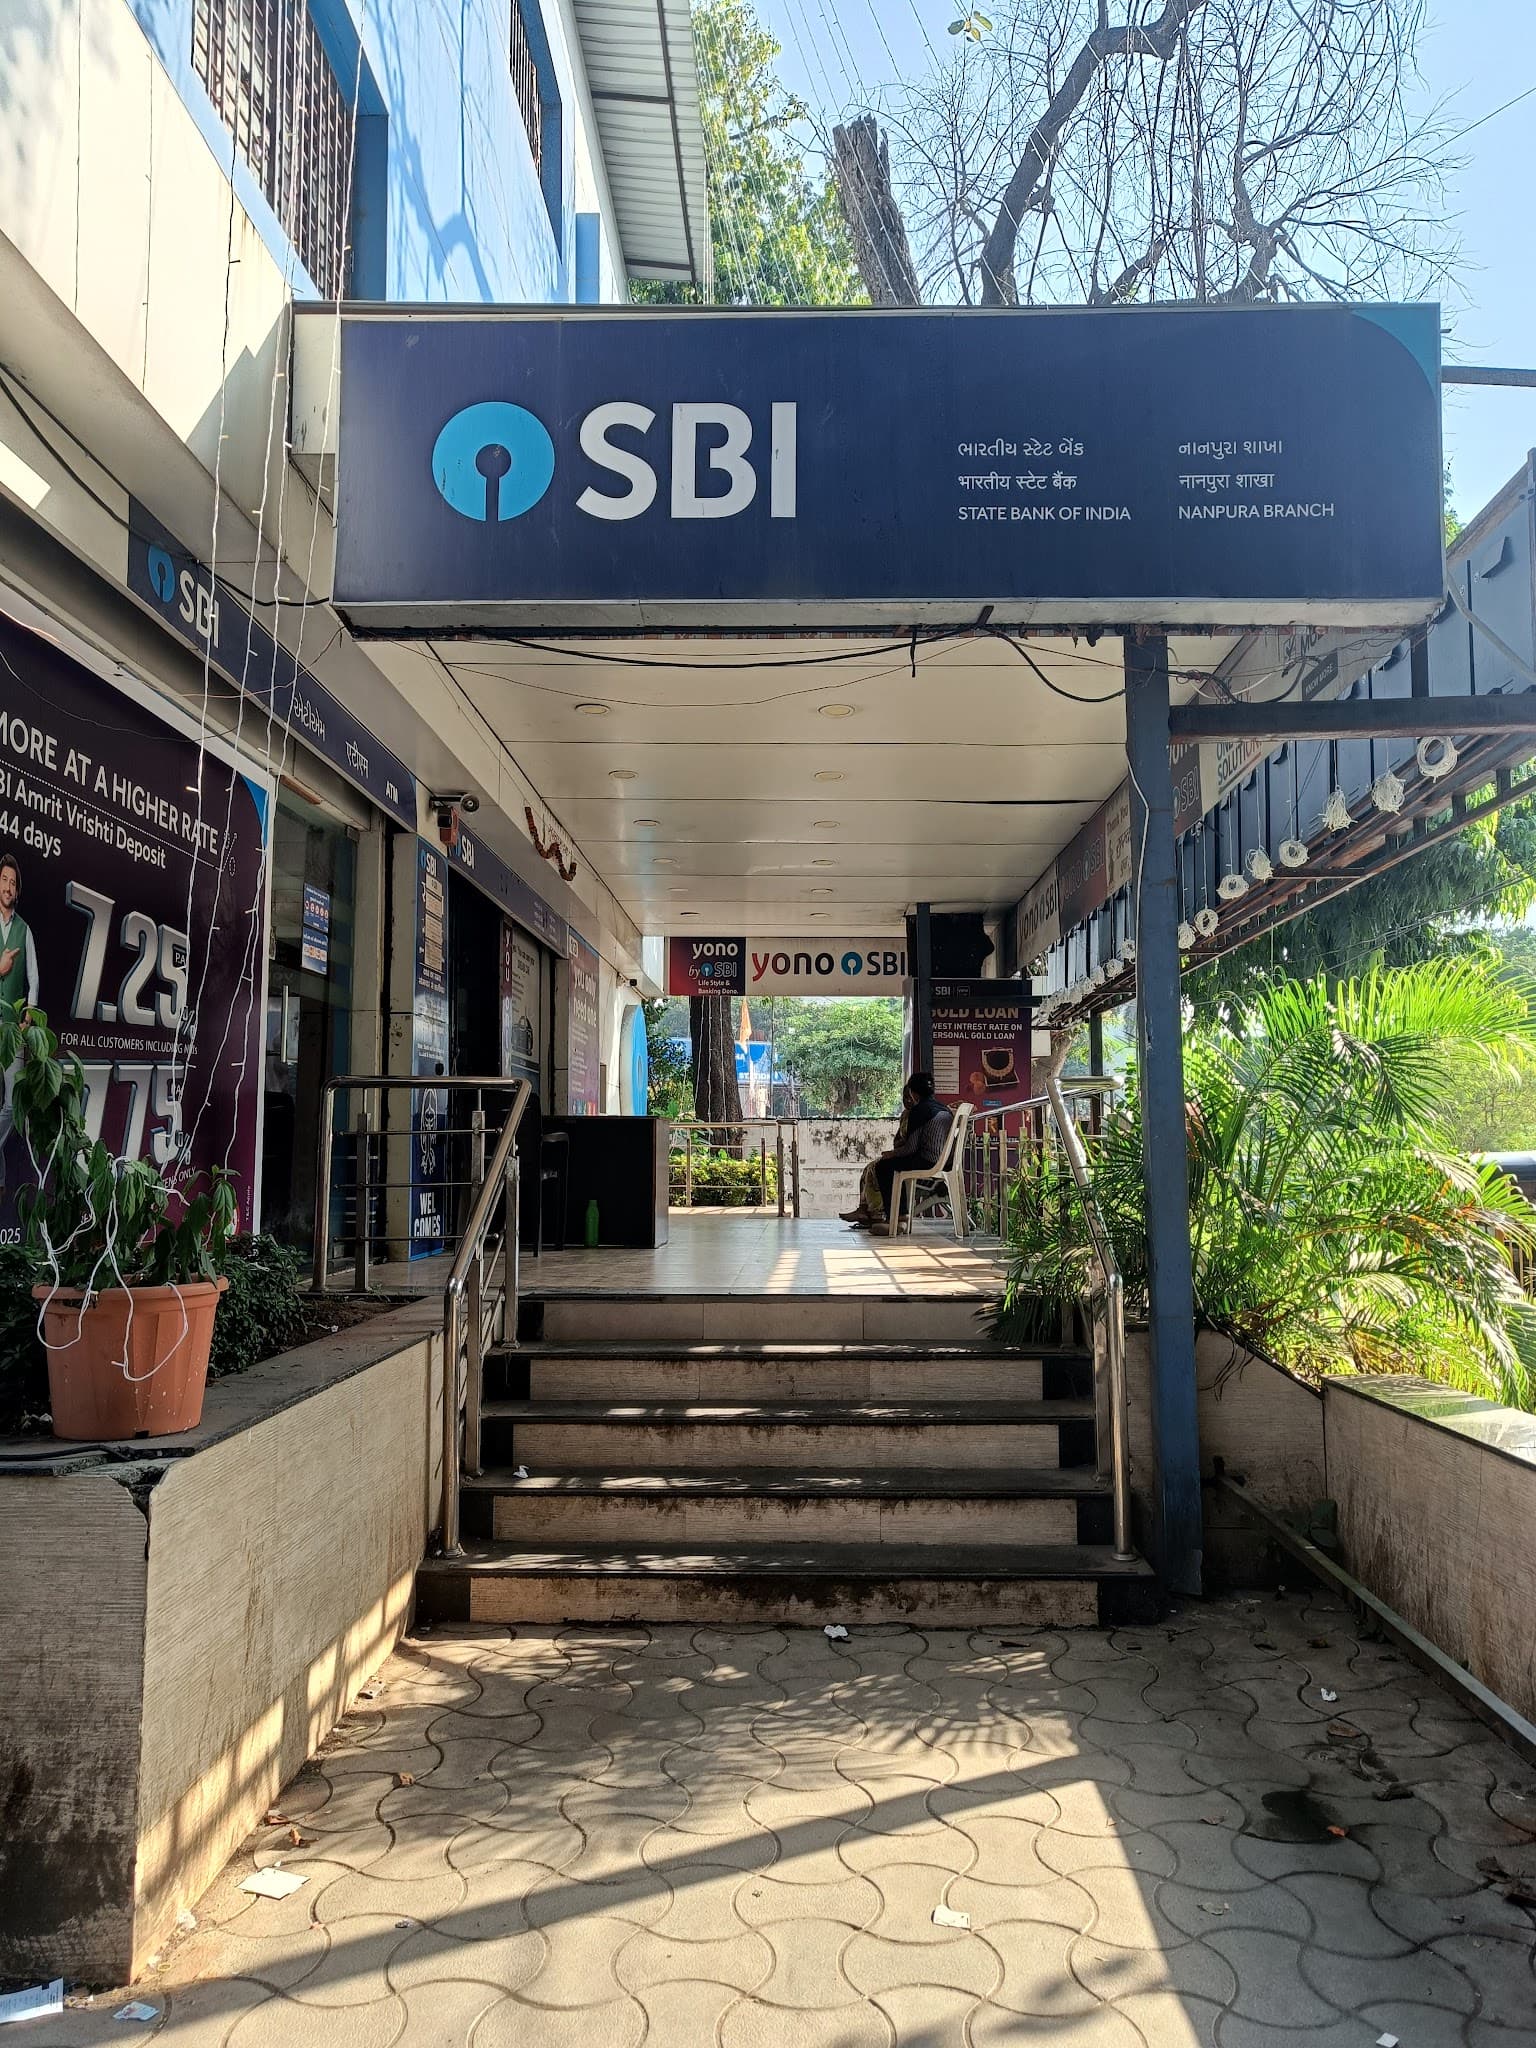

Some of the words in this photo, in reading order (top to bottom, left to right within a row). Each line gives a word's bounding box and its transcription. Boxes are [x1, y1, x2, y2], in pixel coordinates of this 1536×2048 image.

[958, 438, 1017, 456] ભારતીય
[1023, 438, 1053, 456] સ્ટેટ
[1058, 437, 1084, 456] બેંક
[1178, 441, 1237, 460] નાનપુરા
[1243, 440, 1283, 454] શાખા
[576, 402, 796, 520] SBI
[958, 471, 1011, 490] भारतीय
[1016, 470, 1048, 490] स्टेट
[1052, 470, 1078, 490] बैंक
[1179, 474, 1231, 493] नानपुरा
[1235, 473, 1275, 488] शाखा
[958, 507, 1007, 520] STATE
[1010, 507, 1055, 520] BANK
[1059, 507, 1081, 520] OF
[1085, 507, 1132, 520] INDIA
[1178, 505, 1260, 520] NANPURA
[1263, 503, 1335, 518] BRANCH
[179, 569, 219, 648] SBI
[345, 740, 369, 779] एटीएम
[385, 780, 399, 804] ATM
[1180, 765, 1200, 812] SBI
[63, 748, 92, 786] AT
[94, 765, 108, 798] A
[112, 773, 179, 834] HIGHER
[182, 812, 219, 855] RATE
[14, 778, 62, 822] Amrit
[66, 800, 114, 845] Vrishti
[116, 825, 166, 869] Deposit
[23, 820, 62, 859] days
[425, 851, 437, 878] SBI
[461, 835, 475, 870] SBI
[66, 880, 189, 1029] 7.25
[692, 943, 739, 960] yono
[573, 966, 585, 991] you
[714, 961, 737, 977] SBI
[751, 952, 834, 982] yono
[866, 952, 906, 976] SBI
[710, 980, 724, 988] Style
[935, 986, 951, 996] SBI
[573, 997, 587, 1022] need
[954, 1022, 987, 1031] INTREST
[989, 1023, 1009, 1031] RATE
[1011, 1023, 1023, 1031] ON
[971, 1032, 992, 1040] GOLD
[994, 1032, 1015, 1040] LOAN
[60, 1032, 79, 1046] FOR
[80, 1034, 96, 1048] ALL
[97, 1035, 144, 1051] CUSTOMERS
[419, 1191, 437, 1216] WEL
